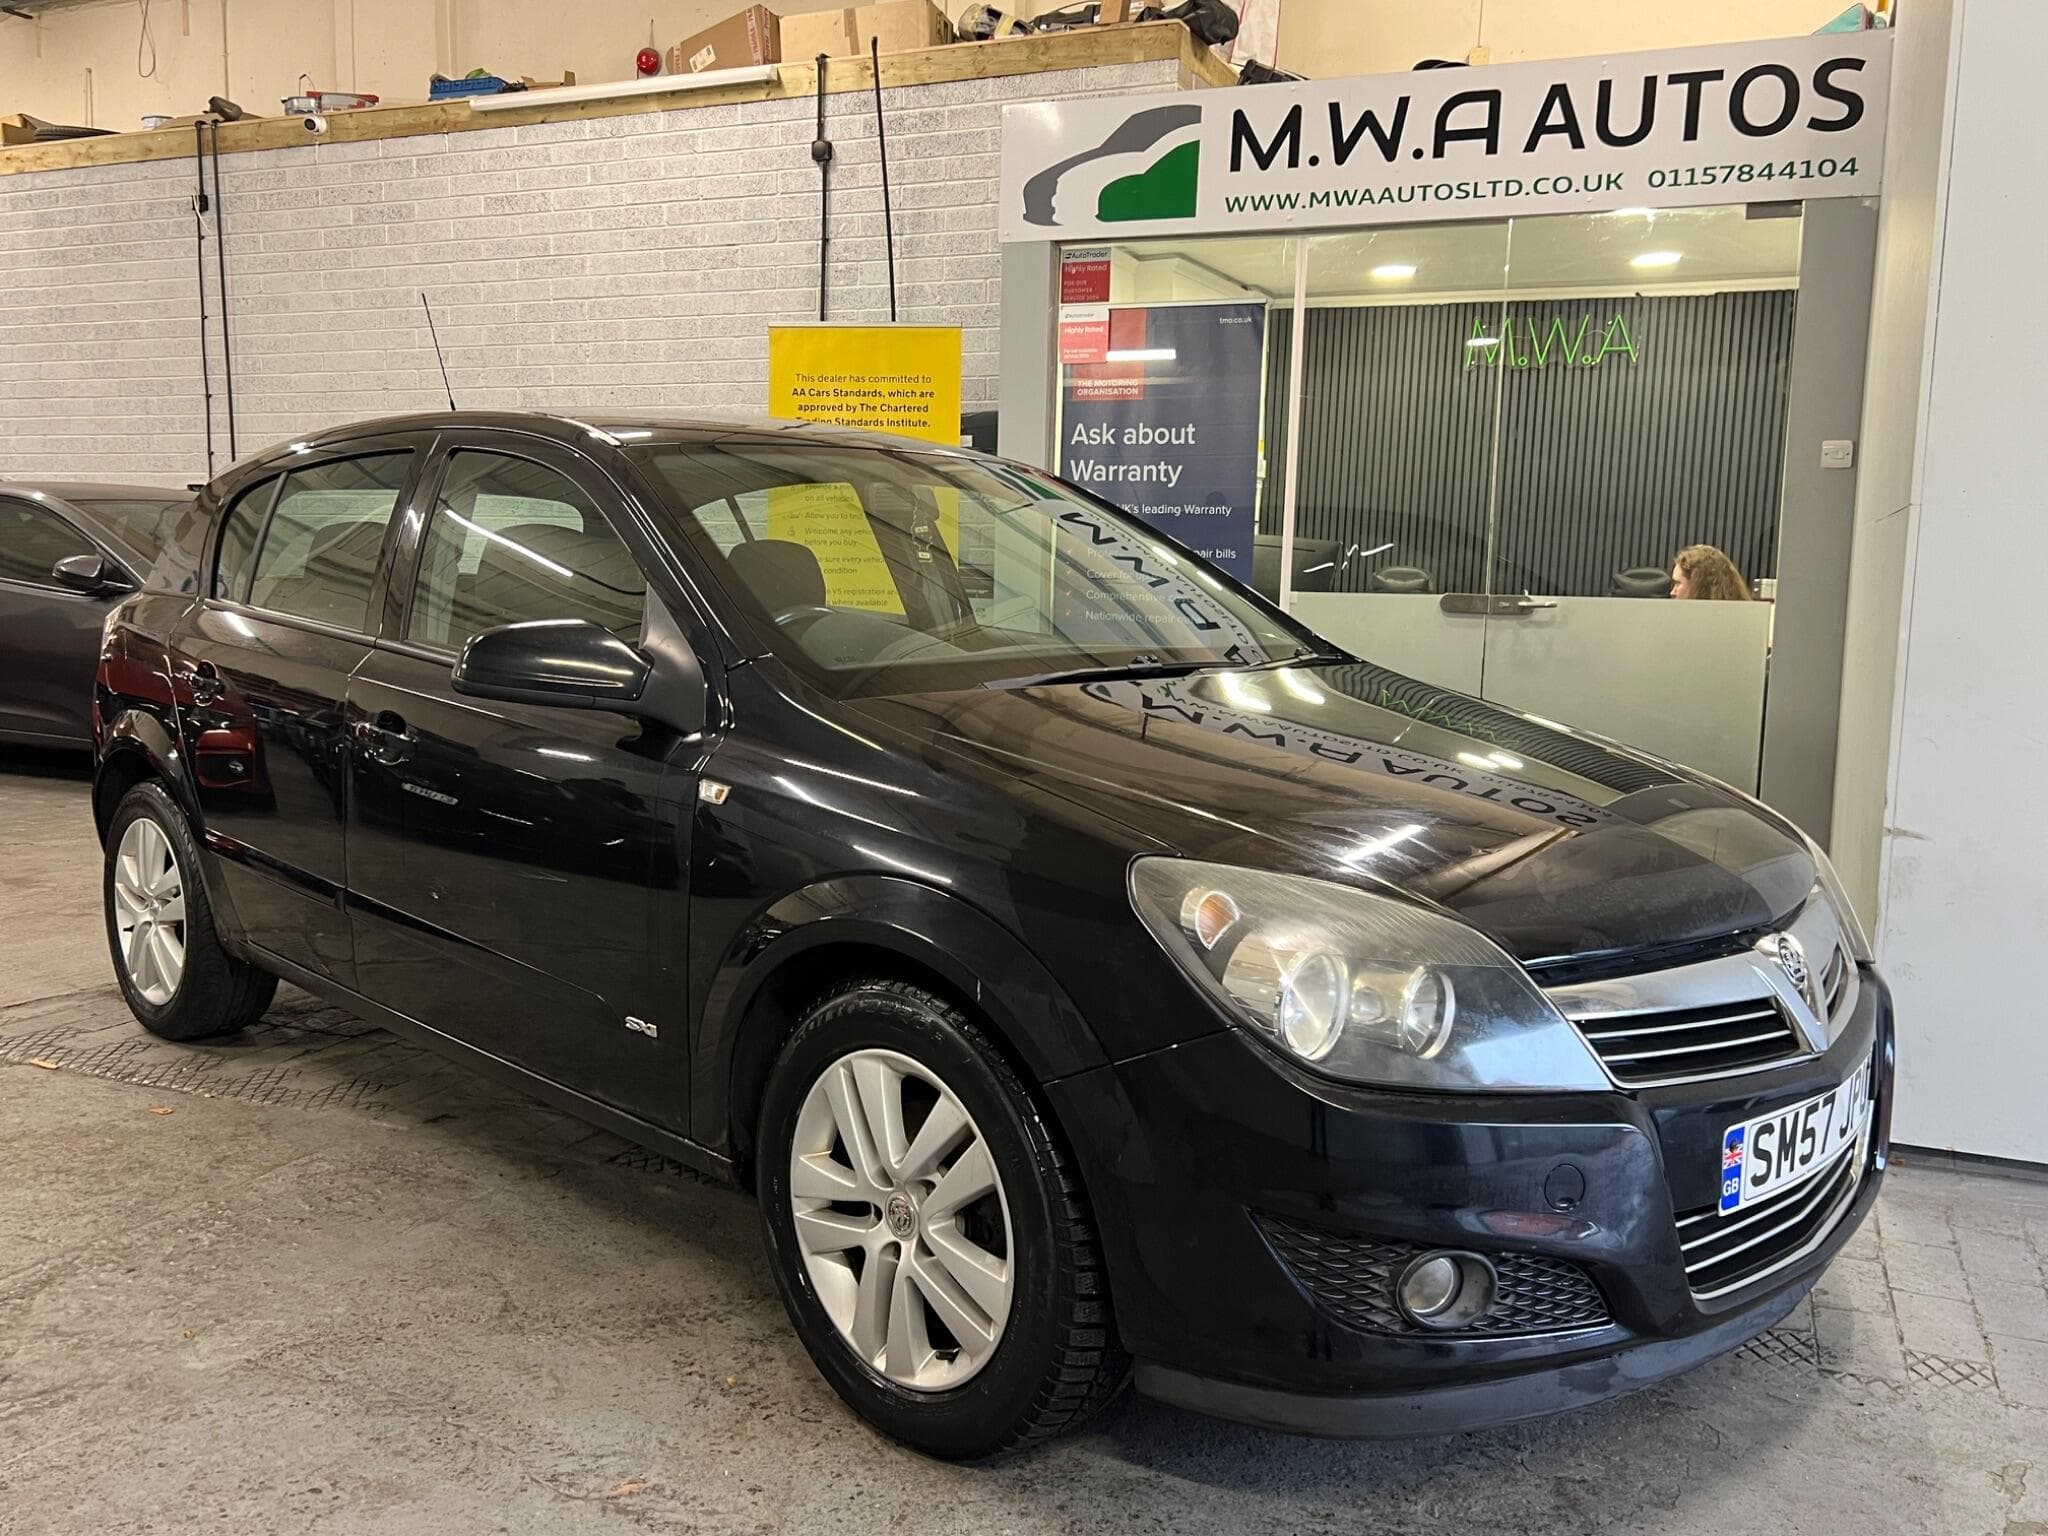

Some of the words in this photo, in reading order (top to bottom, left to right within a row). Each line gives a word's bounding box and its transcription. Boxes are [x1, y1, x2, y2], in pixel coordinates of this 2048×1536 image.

[1229, 88, 1501, 173] M.W.A
[1523, 57, 1866, 154] AUTOS
[1225, 172, 1624, 213] WWW.MWAAUTOSLTD.CO.UK
[1648, 156, 1859, 188] 01157844104
[795, 373, 815, 383] This
[817, 373, 847, 383] dealer
[849, 374, 865, 383] has
[868, 374, 919, 384] committed
[922, 375, 932, 383] to
[1093, 379, 1138, 387] MOTORING
[792, 388, 806, 397] AA
[808, 388, 831, 397] Cars
[833, 388, 886, 398] Standards,
[888, 389, 917, 398] which
[919, 390, 935, 398] are
[1077, 387, 1139, 396] ORGANISATION
[798, 403, 843, 412] approved
[845, 403, 857, 413] by
[859, 403, 877, 412] The
[880, 404, 929, 413] Chartered
[834, 417, 885, 427] Standards
[886, 418, 931, 428] Institute.
[1070, 422, 1116, 446] Ask
[1123, 422, 1196, 446] about
[1070, 460, 1183, 488] Warranty
[1142, 503, 1181, 517] leading
[1184, 503, 1233, 517] Warranty
[1215, 547, 1237, 559] bills
[1086, 569, 1118, 579] Cover
[1085, 610, 1144, 622] Nationwide
[1750, 1090, 1837, 1188] SM57
[1722, 1178, 1740, 1197] GB
